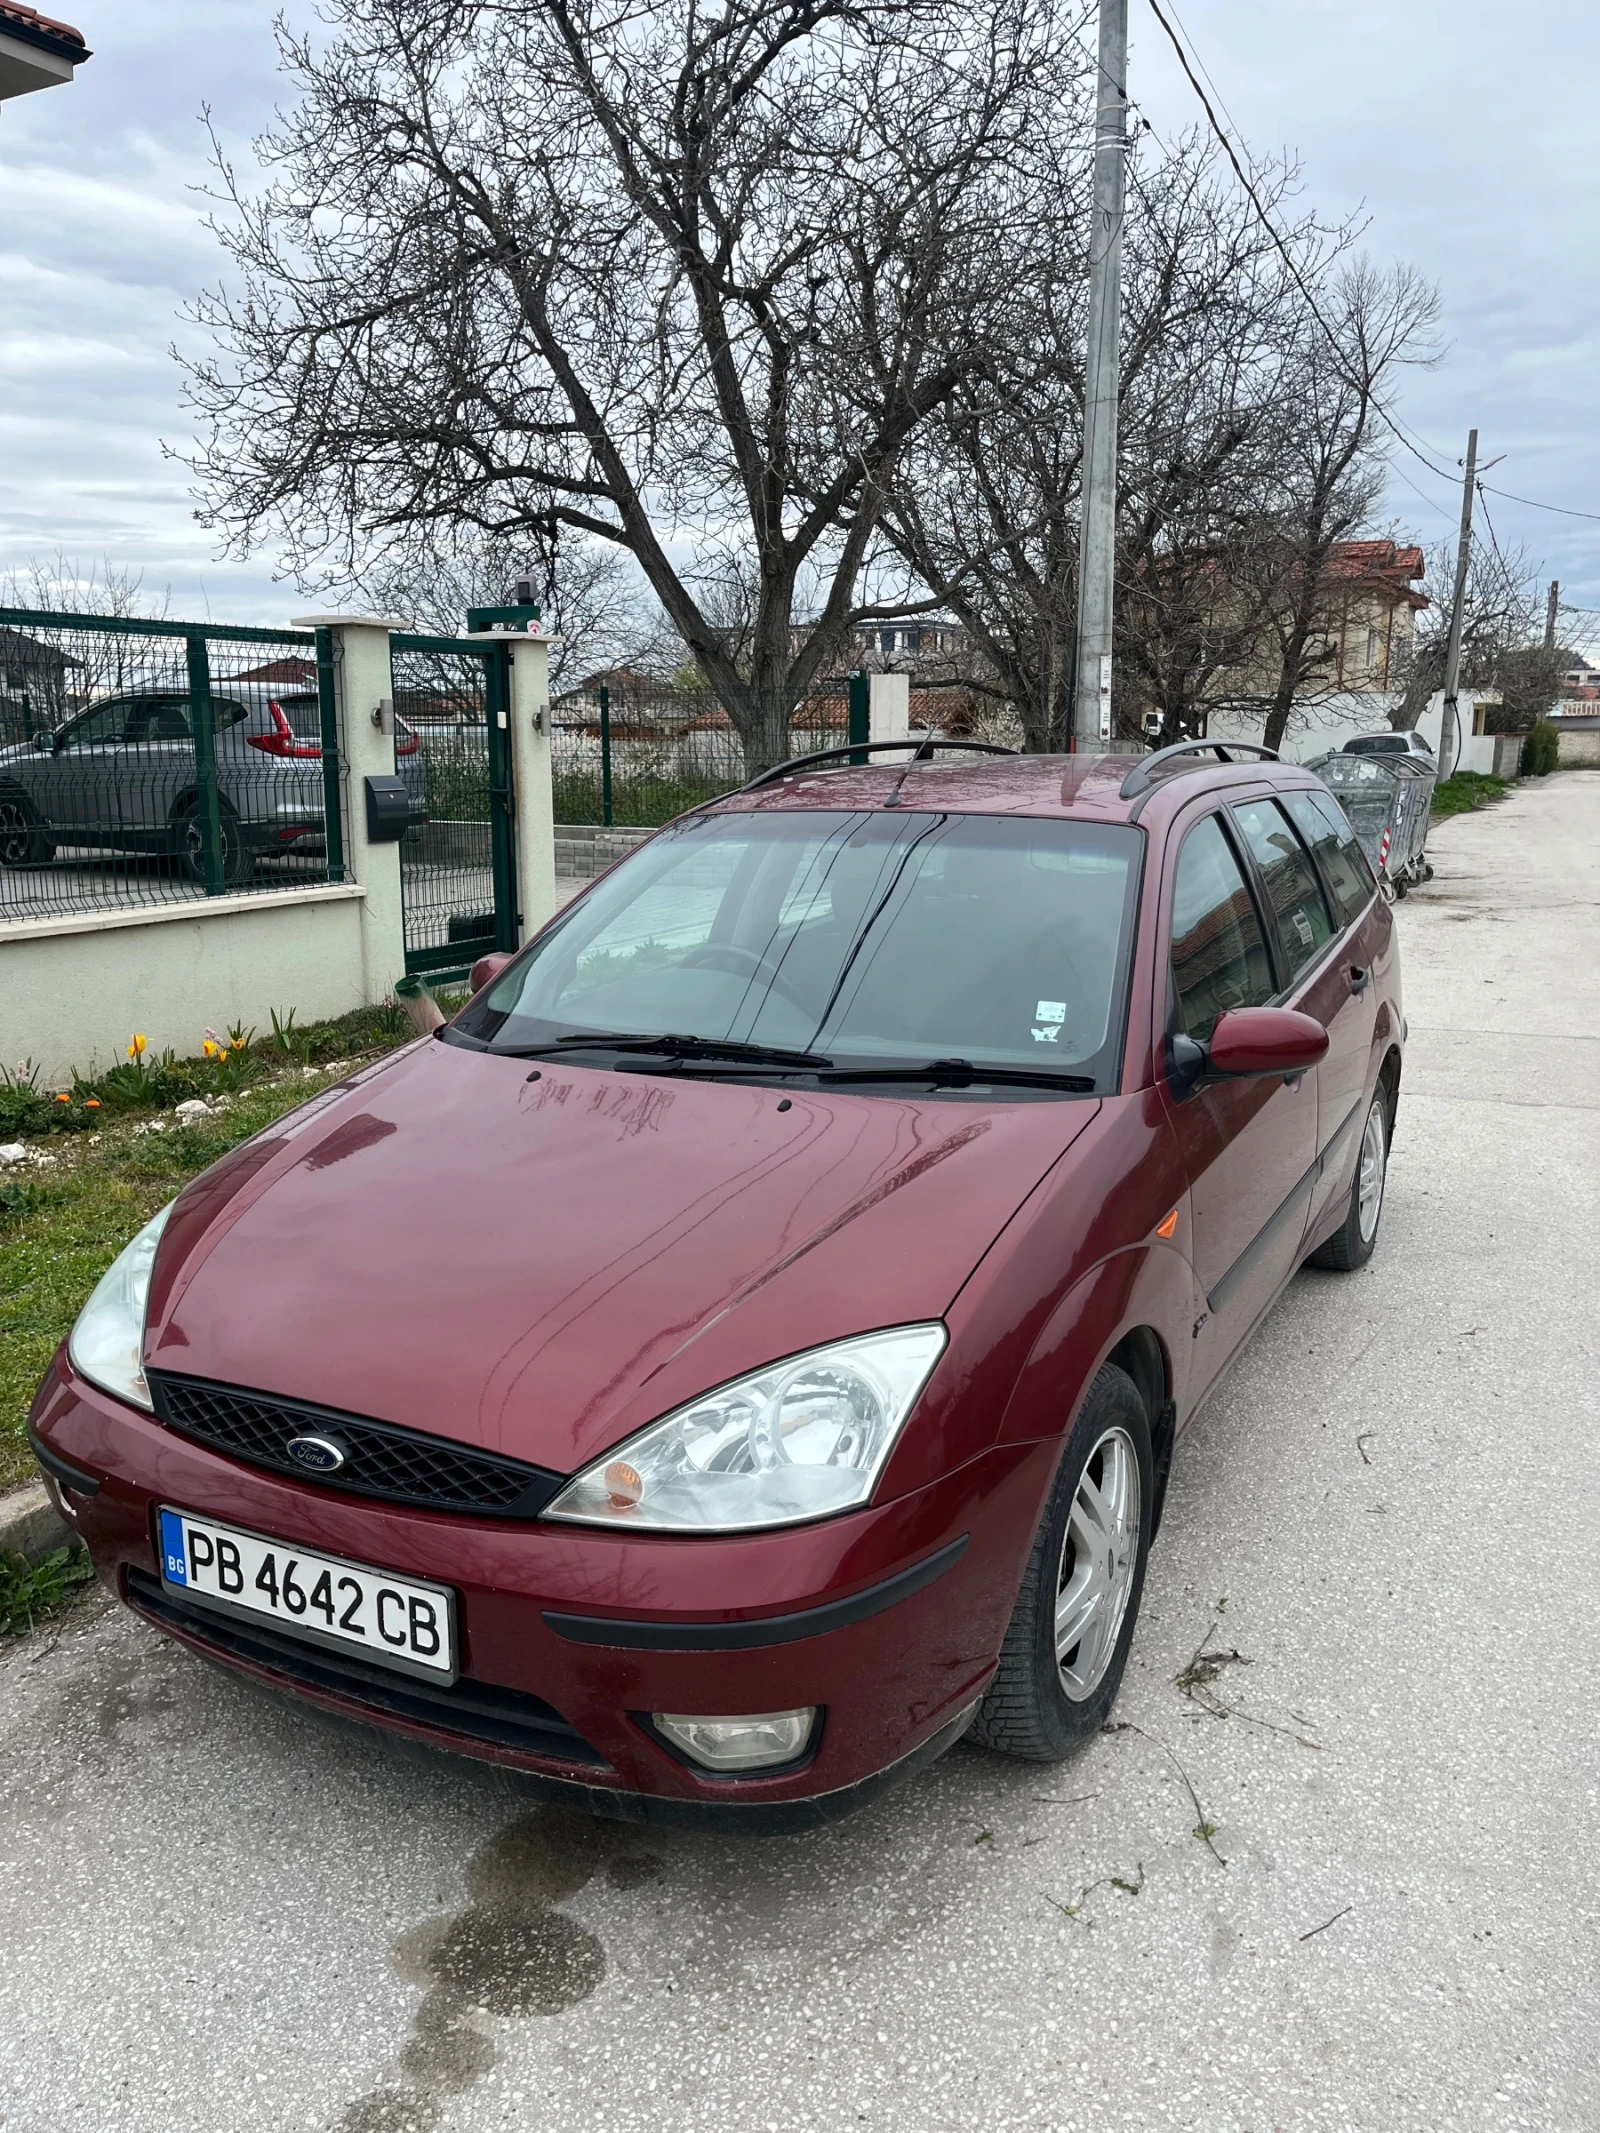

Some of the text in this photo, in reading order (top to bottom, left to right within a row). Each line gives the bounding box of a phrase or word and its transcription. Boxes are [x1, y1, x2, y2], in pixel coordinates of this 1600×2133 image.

[297, 1443, 326, 1465] Ford
[168, 1555, 184, 1575] BG
[188, 1529, 440, 1656] PB 4642 CB
